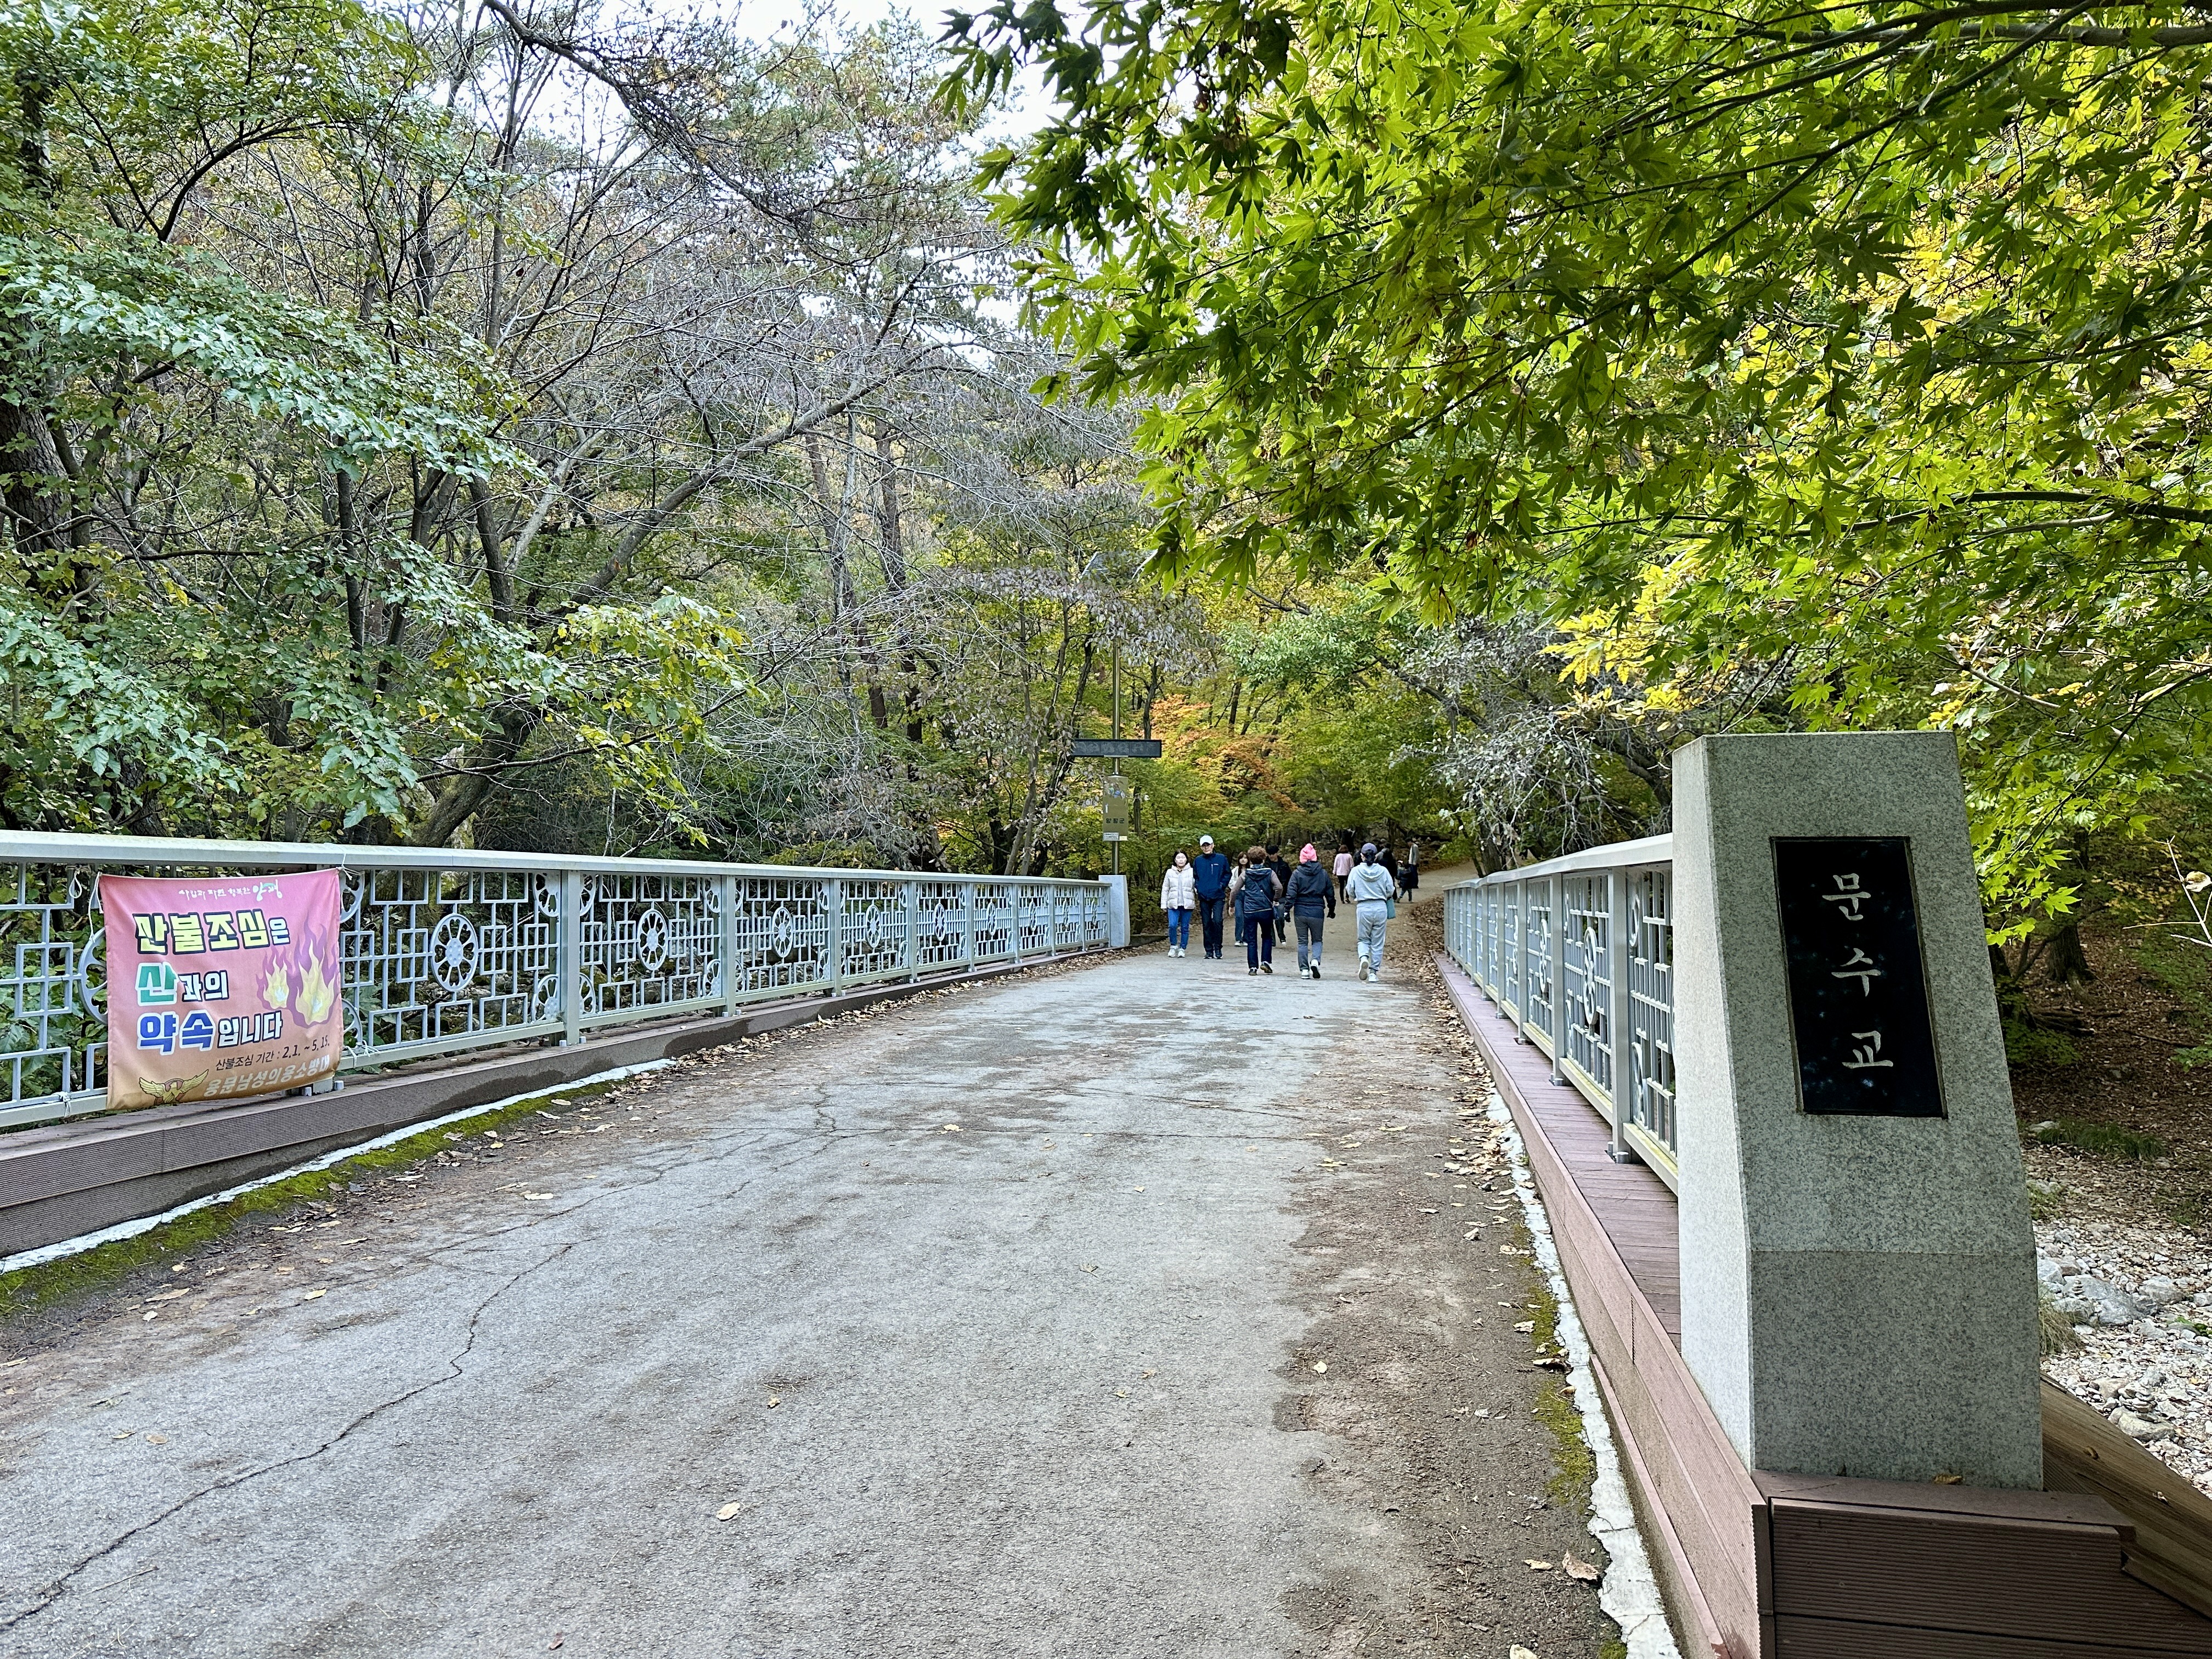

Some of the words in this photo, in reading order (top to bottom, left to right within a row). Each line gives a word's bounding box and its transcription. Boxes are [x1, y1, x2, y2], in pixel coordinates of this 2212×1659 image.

[132, 909, 291, 955] 산불조심은
[135, 961, 229, 1006] 산과의
[1821, 872, 1894, 1069] 문수교
[137, 1009, 283, 1056] 약속입니다
[204, 1054, 330, 1097] 용문남성의용소방대
[216, 1054, 253, 1071] 산불조심
[256, 1051, 274, 1063] 기간
